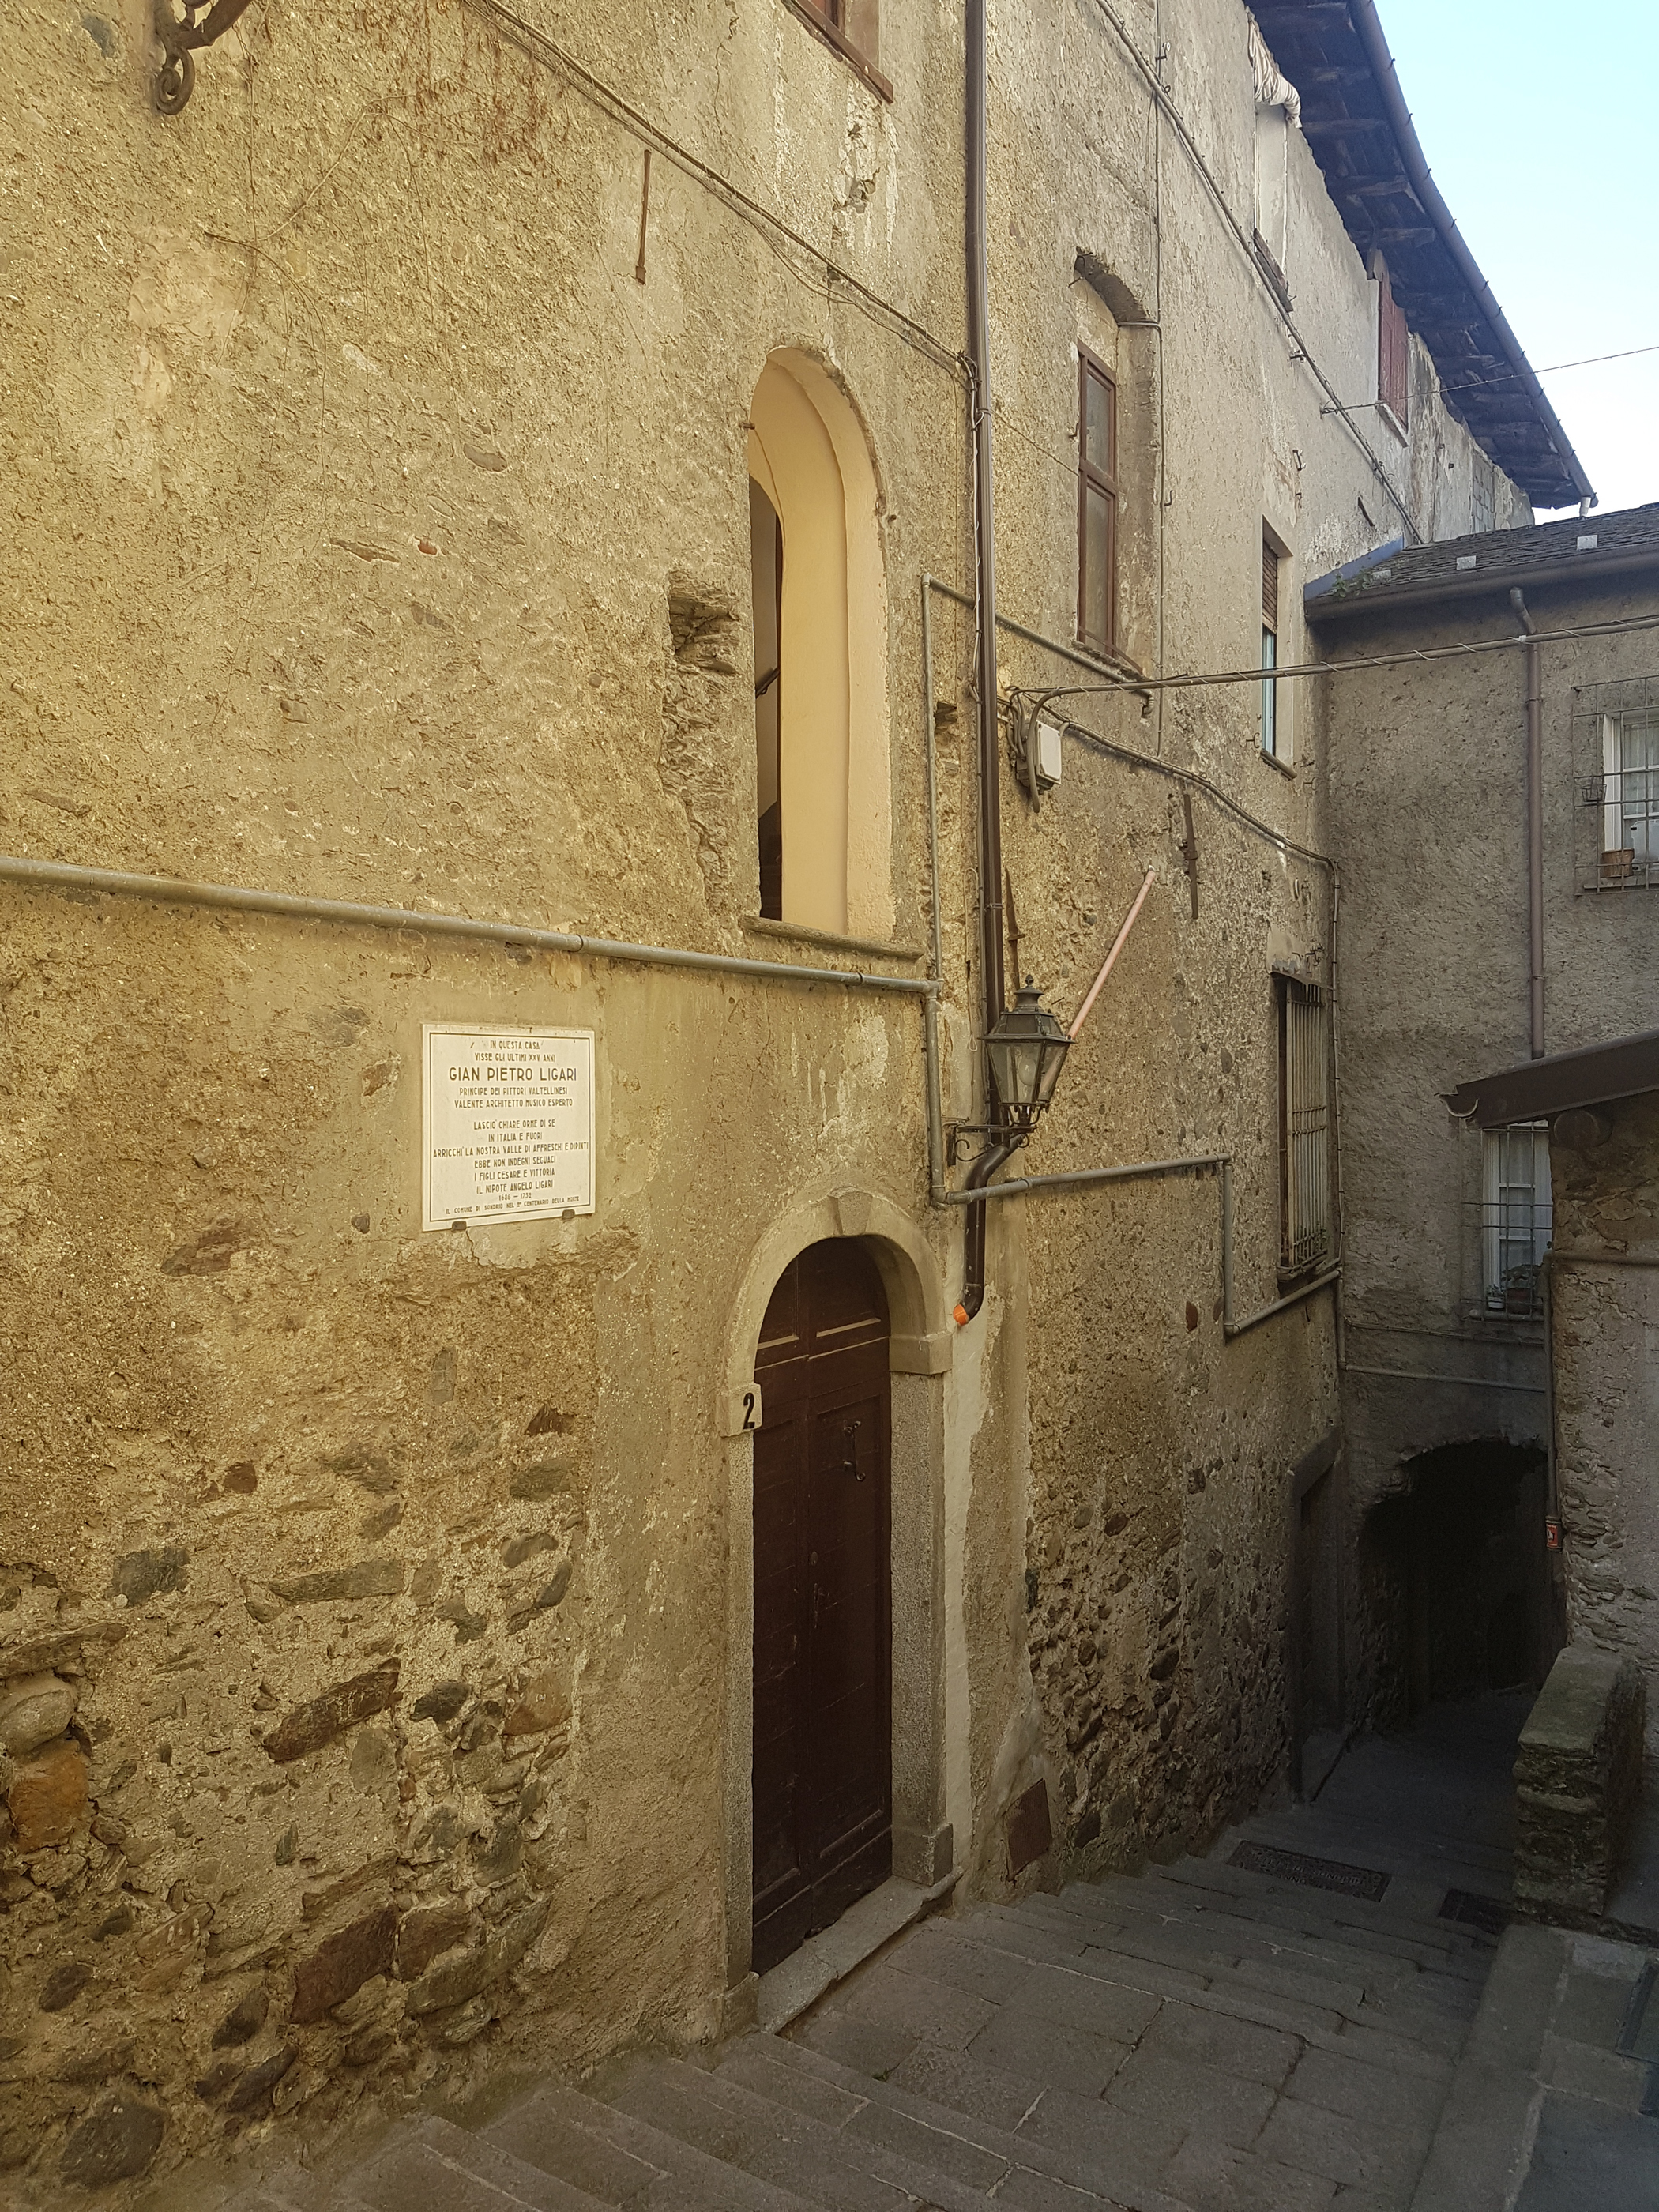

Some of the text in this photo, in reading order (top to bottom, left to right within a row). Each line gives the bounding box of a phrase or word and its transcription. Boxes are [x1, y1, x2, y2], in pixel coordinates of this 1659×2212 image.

[490, 1040, 540, 1050] IN QUESTA CASA
[475, 1052, 492, 1061] VISSE
[507, 1053, 527, 1062] ULTIMI
[449, 1066, 577, 1082] GIAN PIETRO LIGARI
[459, 1086, 568, 1096] PRINCIPE DEI PITTORI VALTELLINESI
[454, 1099, 483, 1108] VALENTE
[486, 1099, 524, 1108] ARCHITETTO
[548, 1098, 573, 1107] ESPERTO
[498, 1120, 521, 1129] CHIARE
[522, 1119, 538, 1128] ORME
[540, 1119, 546, 1127] DI
[488, 1131, 543, 1142] IN ITALIA E FUORI
[465, 1147, 474, 1157] LA
[476, 1146, 500, 1156] NOSTRA
[502, 1145, 522, 1154] VALLE
[525, 1144, 531, 1153] DI
[532, 1142, 563, 1153] AFFRESCHI
[565, 1142, 569, 1151] E
[570, 1142, 589, 1150] DIPINTI
[474, 1155, 556, 1169] EBBE NON INDEGNI SEGUACI
[479, 1172, 495, 1181] FIGLI
[497, 1170, 521, 1179] CESARE
[523, 1169, 528, 1178] E
[529, 1168, 555, 1177] VITTORIA
[476, 1179, 553, 1194] IL NIPOTE ANGELO LIGARI
[453, 1206, 473, 1214] COMUNE
[524, 1198, 549, 1207] CENTENARIO
[743, 1393, 754, 1429] 2
